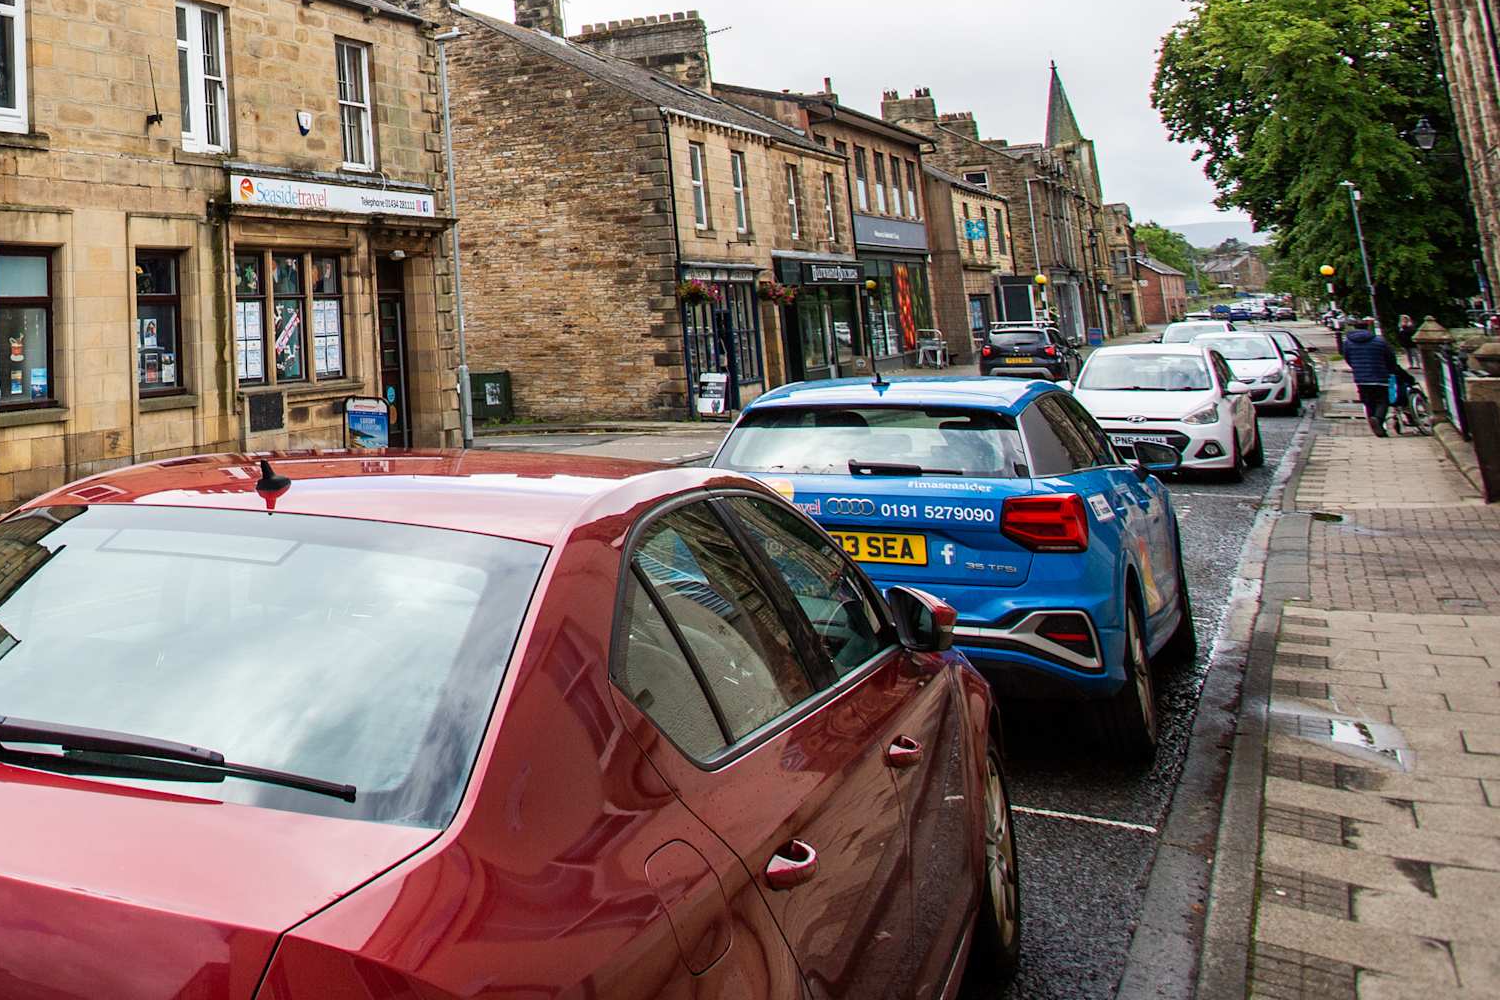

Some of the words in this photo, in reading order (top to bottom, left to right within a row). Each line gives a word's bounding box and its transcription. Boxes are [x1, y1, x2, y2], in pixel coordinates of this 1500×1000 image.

[255, 182, 328, 208] Seasidetravel
[361, 196, 384, 208] Telephone
[907, 480, 992, 494] #imaseasider
[880, 503, 917, 518] 0191
[924, 505, 995, 522] 5279090
[866, 536, 914, 560] SEA
[965, 562, 985, 571] 35
[989, 564, 1017, 573] TFSI
